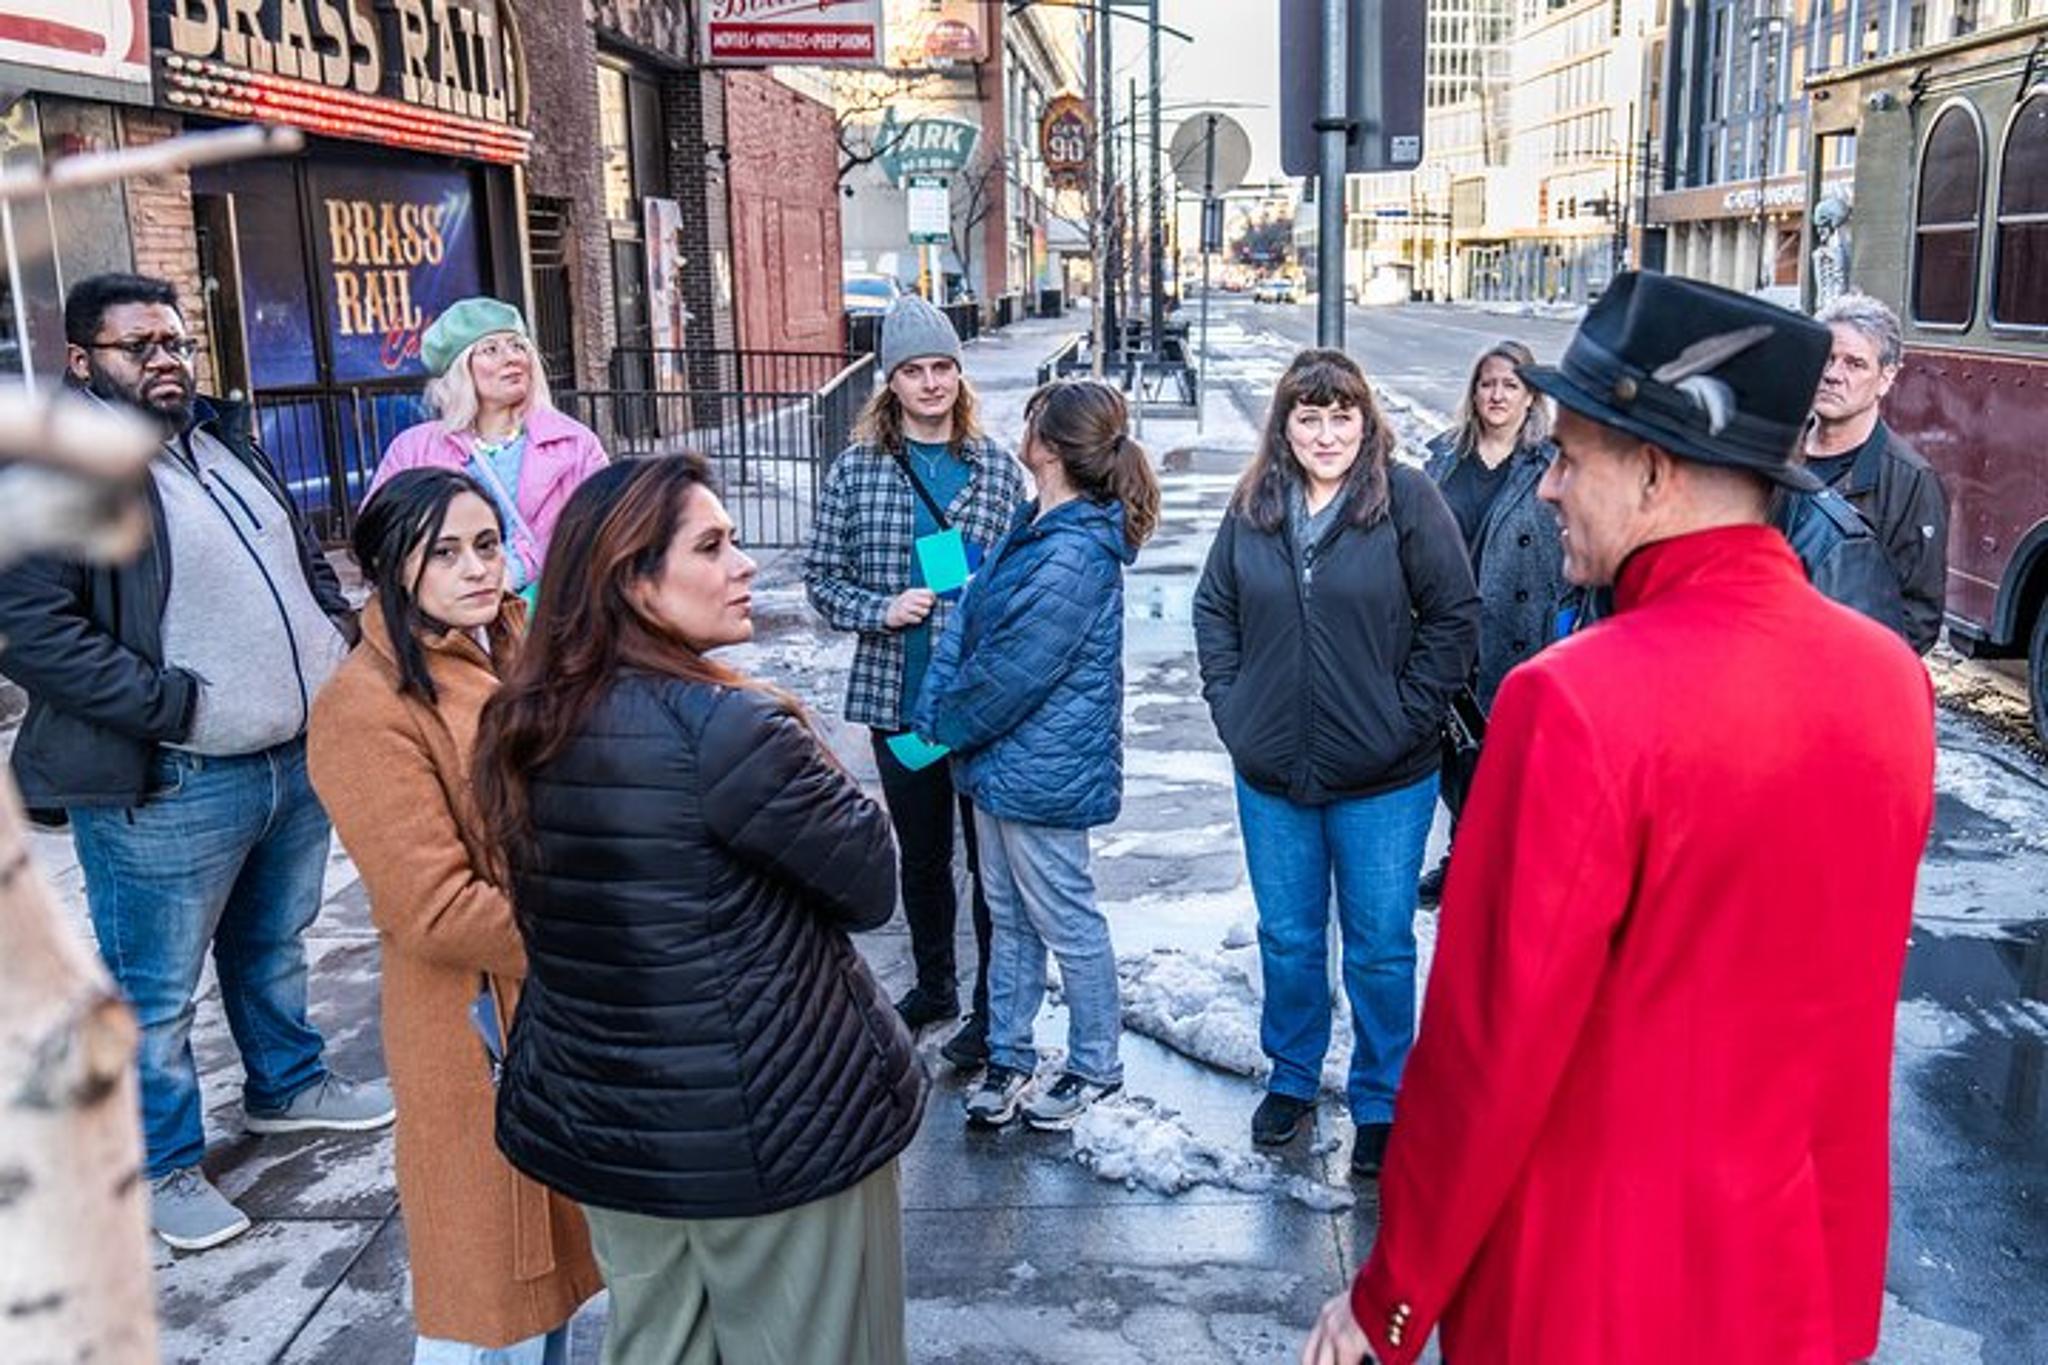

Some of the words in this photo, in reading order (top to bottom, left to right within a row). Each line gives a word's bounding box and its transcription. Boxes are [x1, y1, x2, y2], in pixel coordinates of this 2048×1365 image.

[394, 0, 507, 124] RAIL
[814, 33, 872, 51] PEEPSHOWS
[325, 199, 444, 266] BRASS
[334, 269, 422, 336] RAIL
